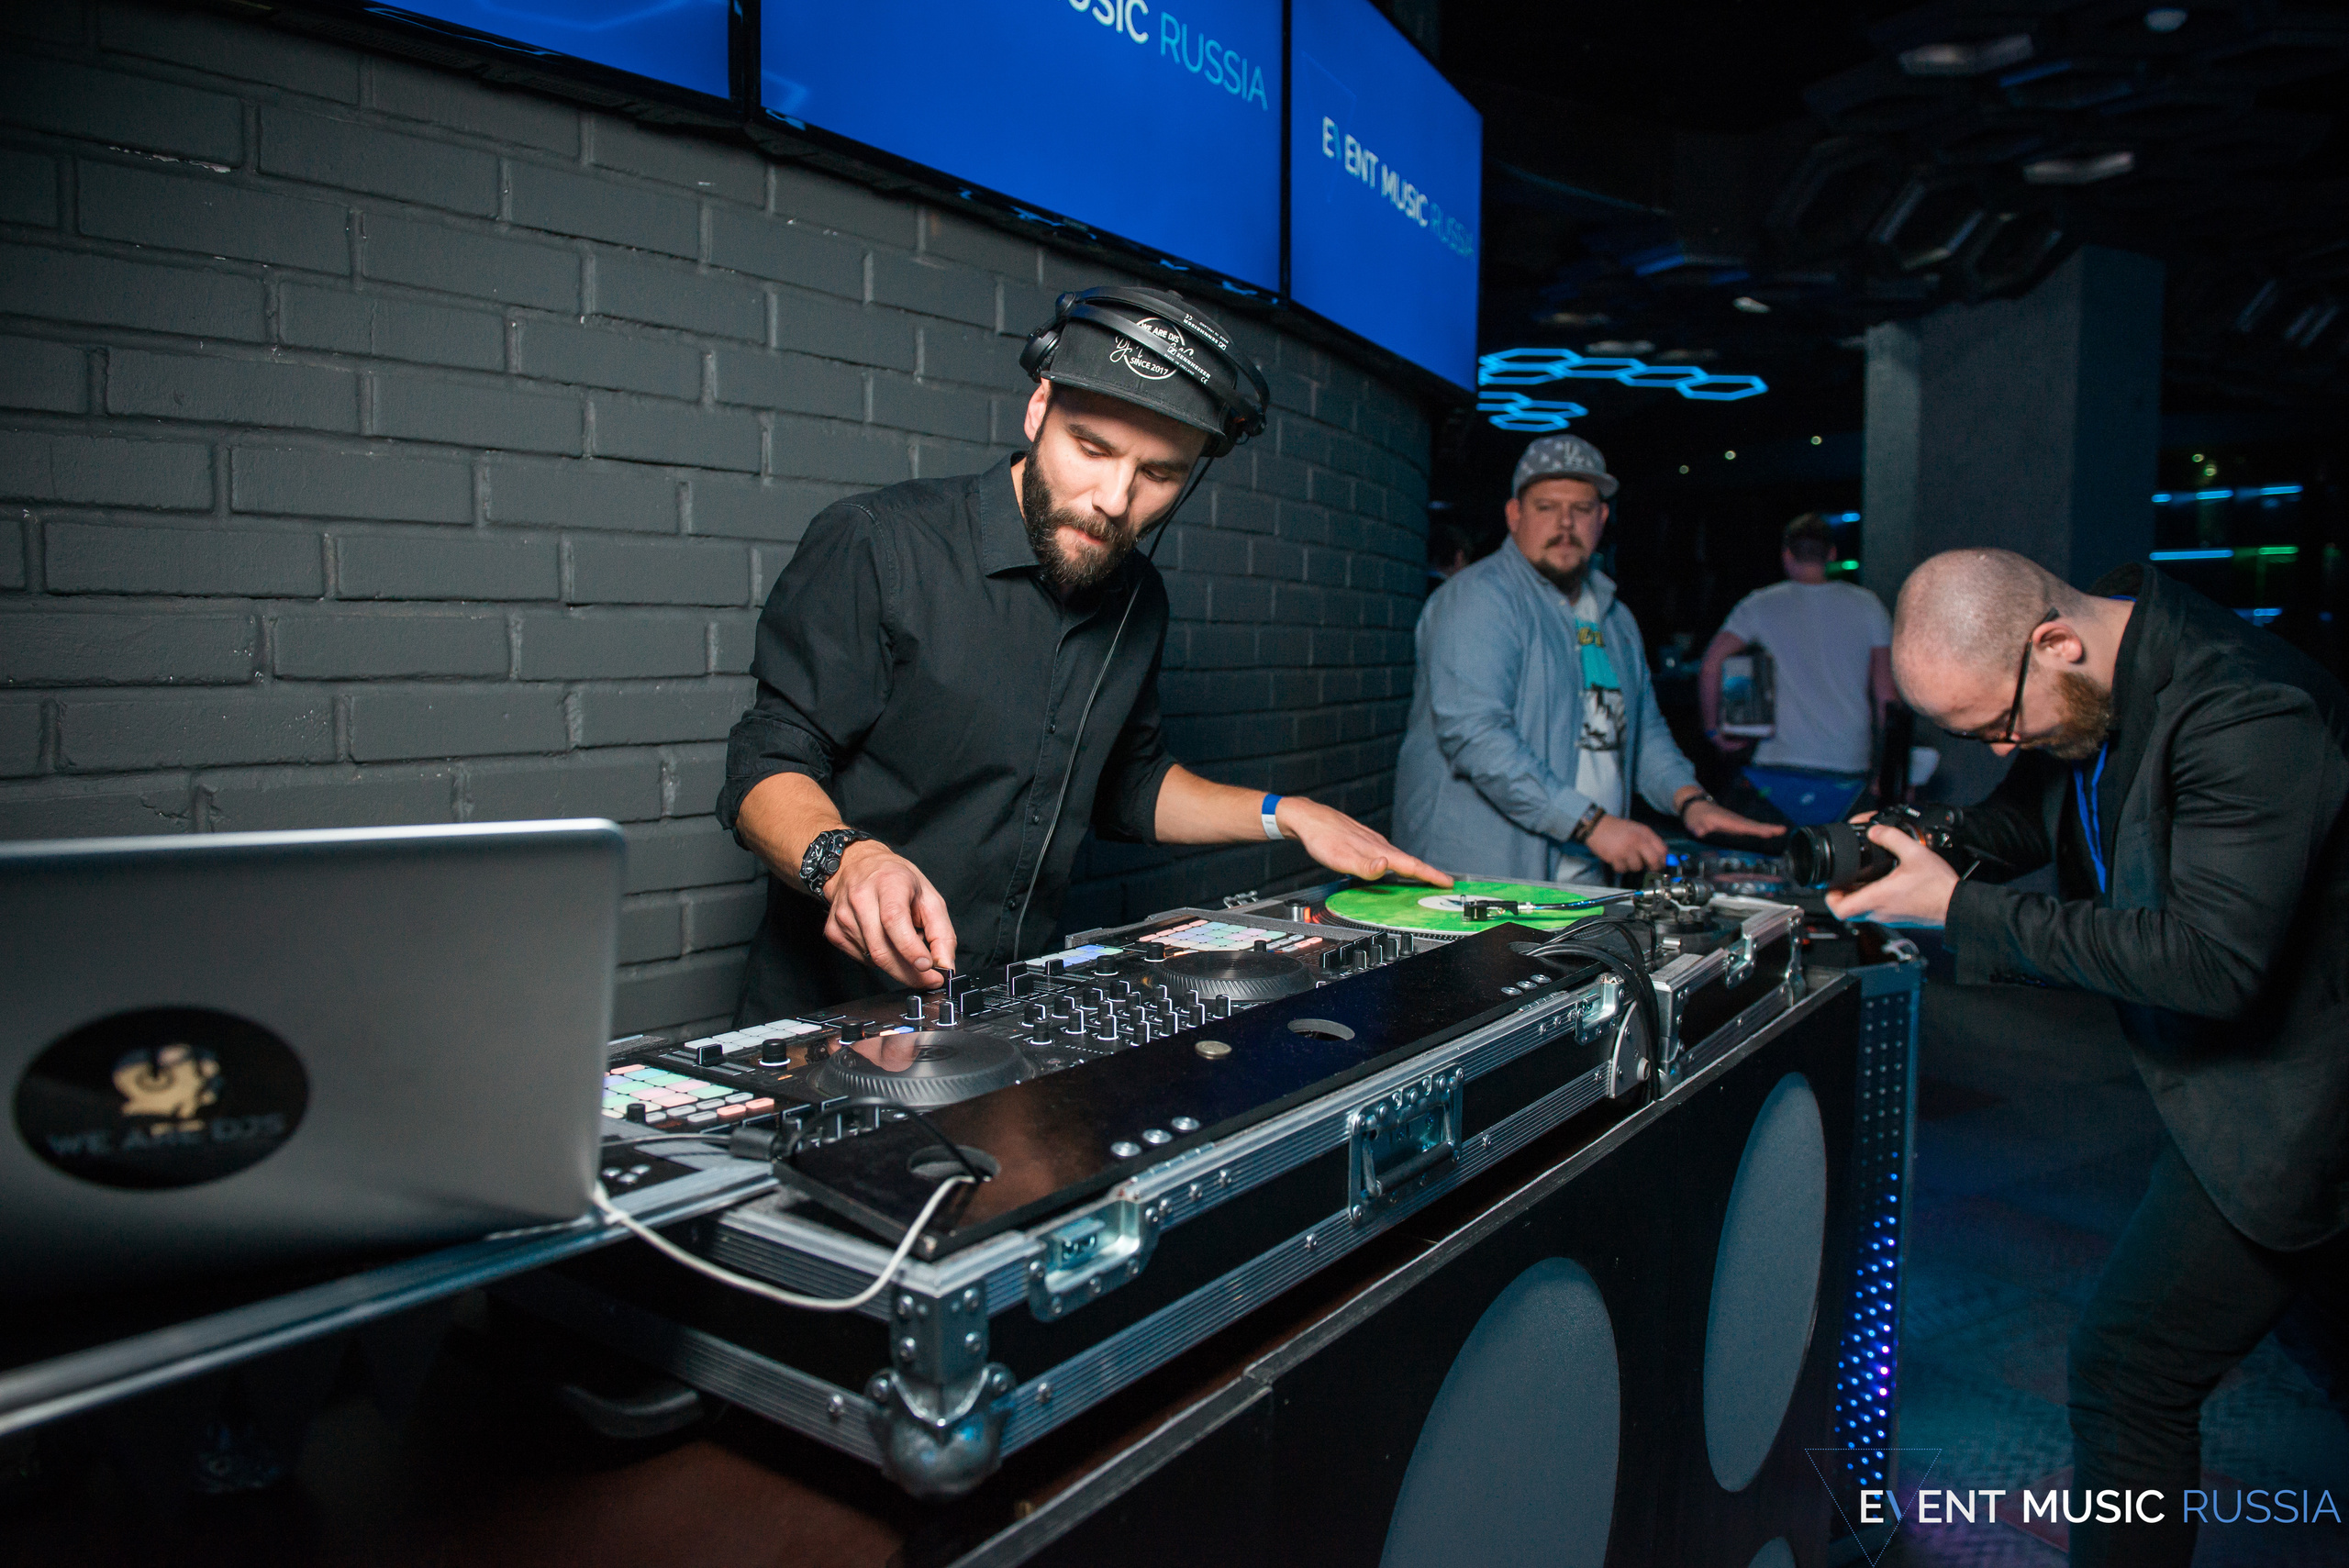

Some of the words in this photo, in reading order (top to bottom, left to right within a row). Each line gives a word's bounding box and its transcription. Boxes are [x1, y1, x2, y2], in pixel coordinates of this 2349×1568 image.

[1160, 11, 1268, 111] RUSSIA
[1381, 162, 1429, 228] MUSIC
[1430, 202, 1475, 263] RUSSIA
[1152, 327, 1167, 339] ARE
[1129, 357, 1151, 370] SINCE
[1150, 363, 1170, 376] 2017
[1175, 352, 1211, 379] SENNHEISER
